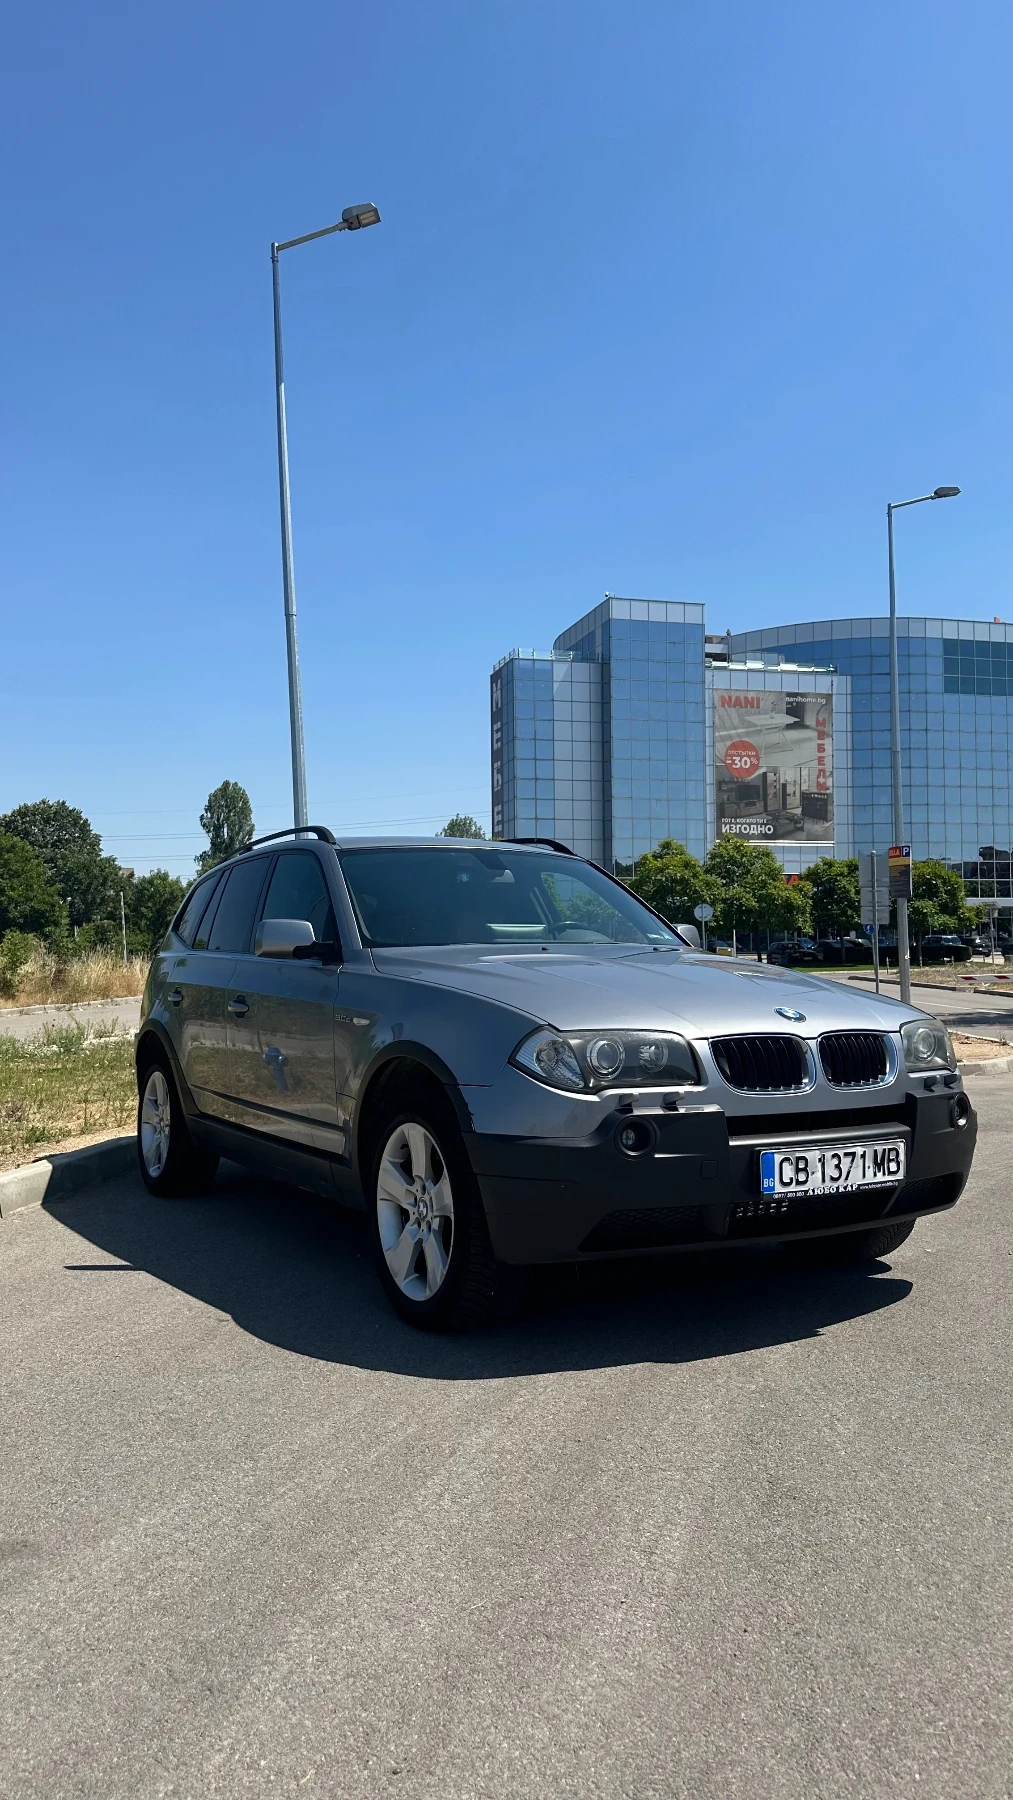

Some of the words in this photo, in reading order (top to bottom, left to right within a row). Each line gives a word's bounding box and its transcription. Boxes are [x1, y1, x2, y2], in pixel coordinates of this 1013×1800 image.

[721, 695, 760, 709] NANI
[786, 696, 826, 704] nanihome.bg
[721, 824, 774, 835] ИЗГОДНО
[902, 847, 910, 856] P
[763, 1178, 774, 1188] BG
